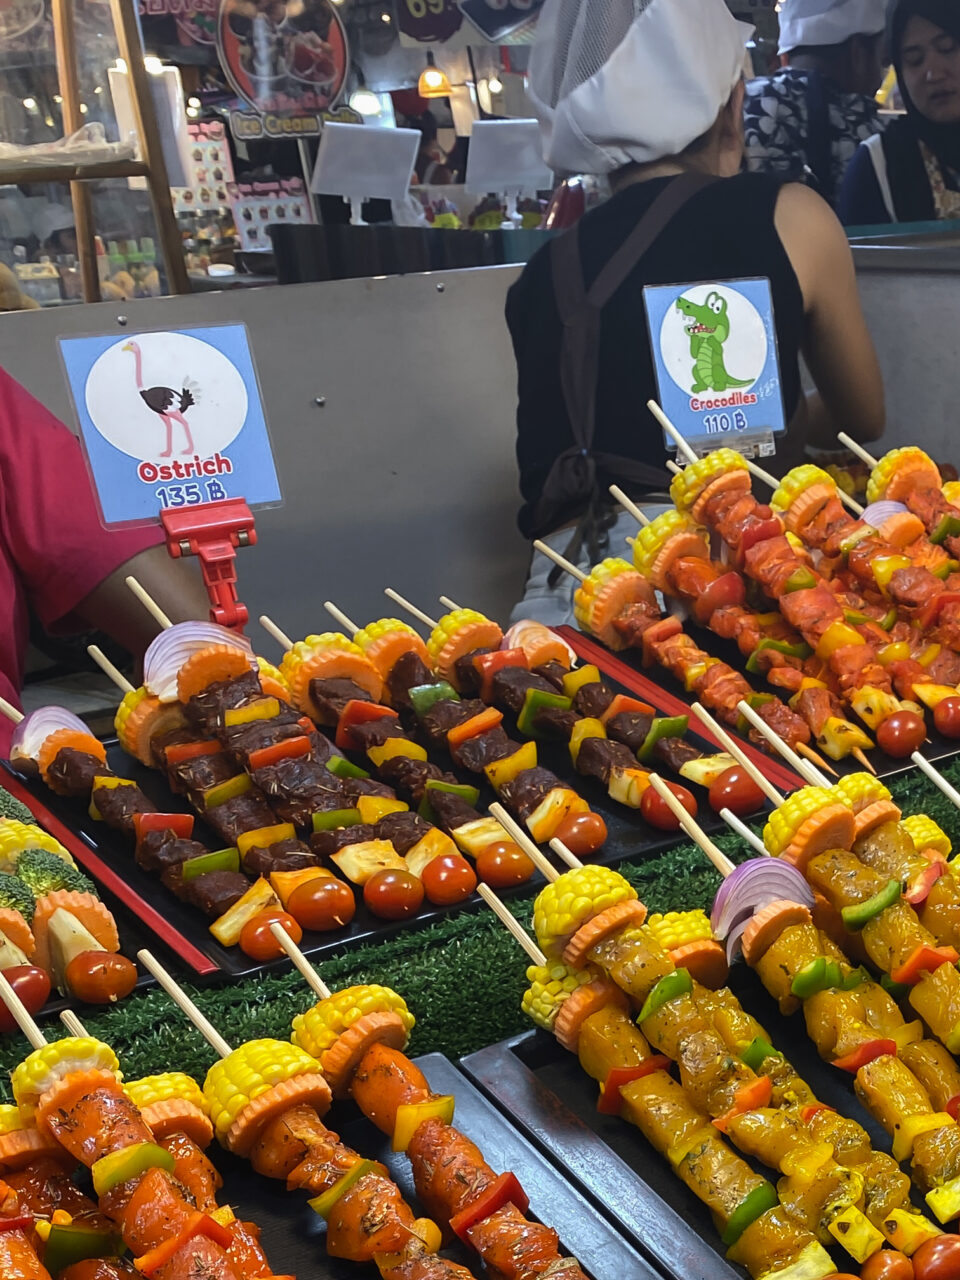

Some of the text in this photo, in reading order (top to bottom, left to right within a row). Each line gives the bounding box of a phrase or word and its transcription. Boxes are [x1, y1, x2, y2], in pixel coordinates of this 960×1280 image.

[265, 115, 319, 133] Cream
[690, 391, 757, 411] Crocodiles
[704, 414, 730, 433] 110
[139, 452, 232, 482] Ostrich
[157, 484, 201, 508] 135
